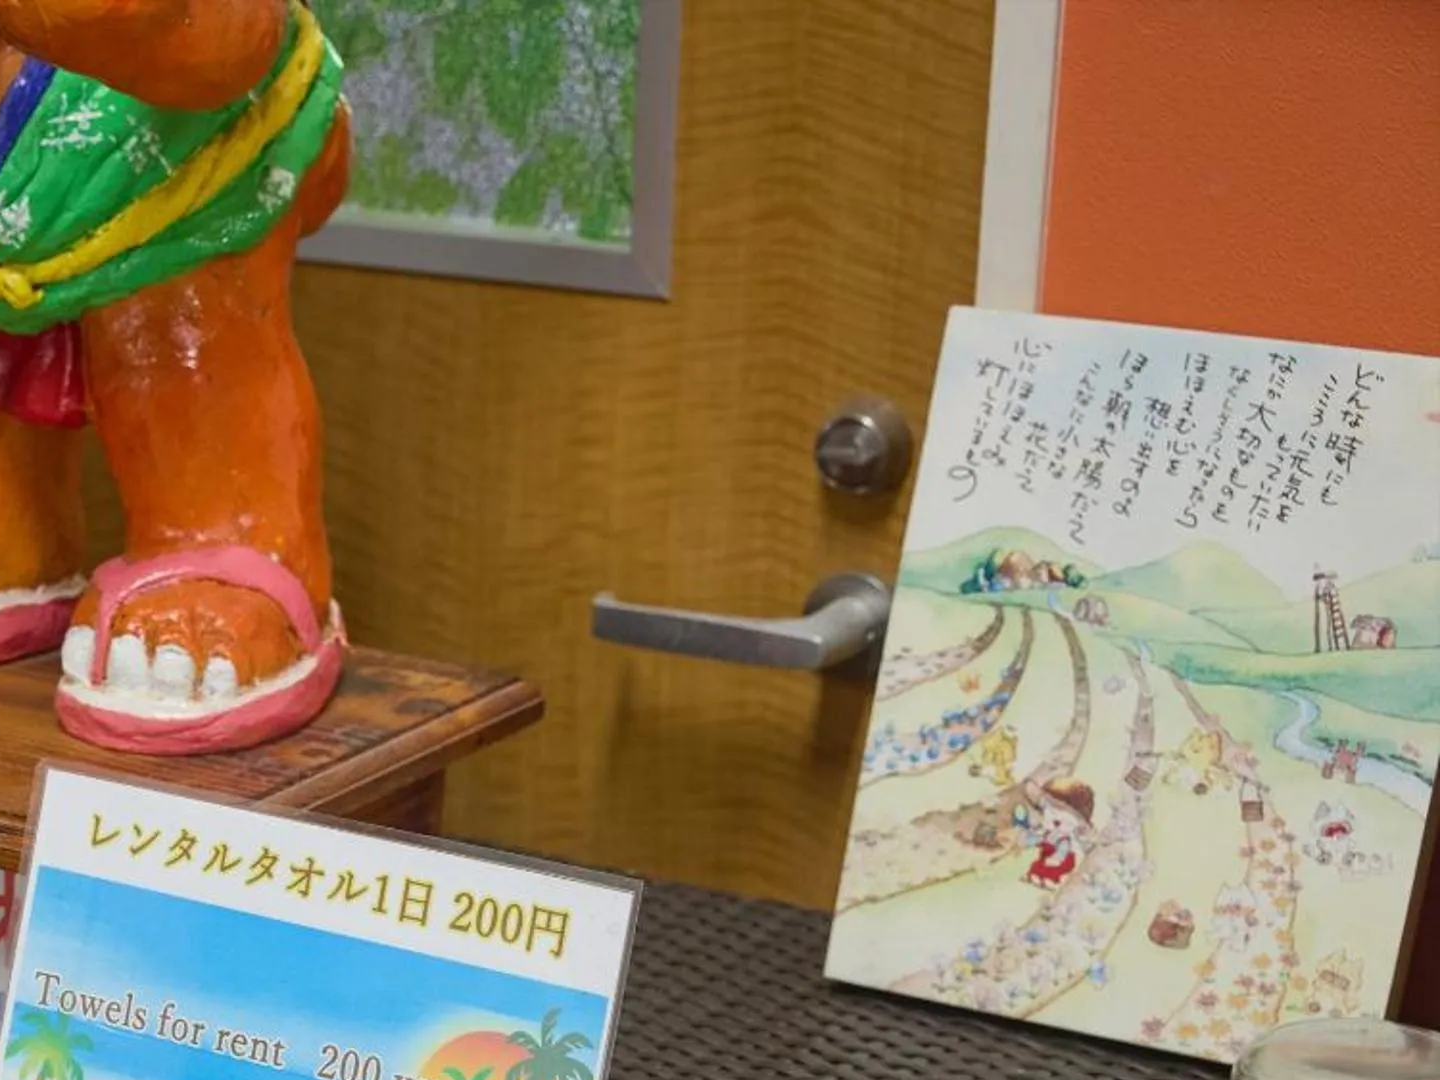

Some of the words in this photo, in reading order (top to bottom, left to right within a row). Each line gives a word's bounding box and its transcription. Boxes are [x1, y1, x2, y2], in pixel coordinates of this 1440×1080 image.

[1320, 363, 1386, 507] どんな時にも
[89, 812, 434, 929] レンタルタオル1日
[449, 891, 570, 960] 200円
[34, 970, 147, 1032] Towels
[157, 1003, 205, 1046] for
[215, 1023, 286, 1068] rent
